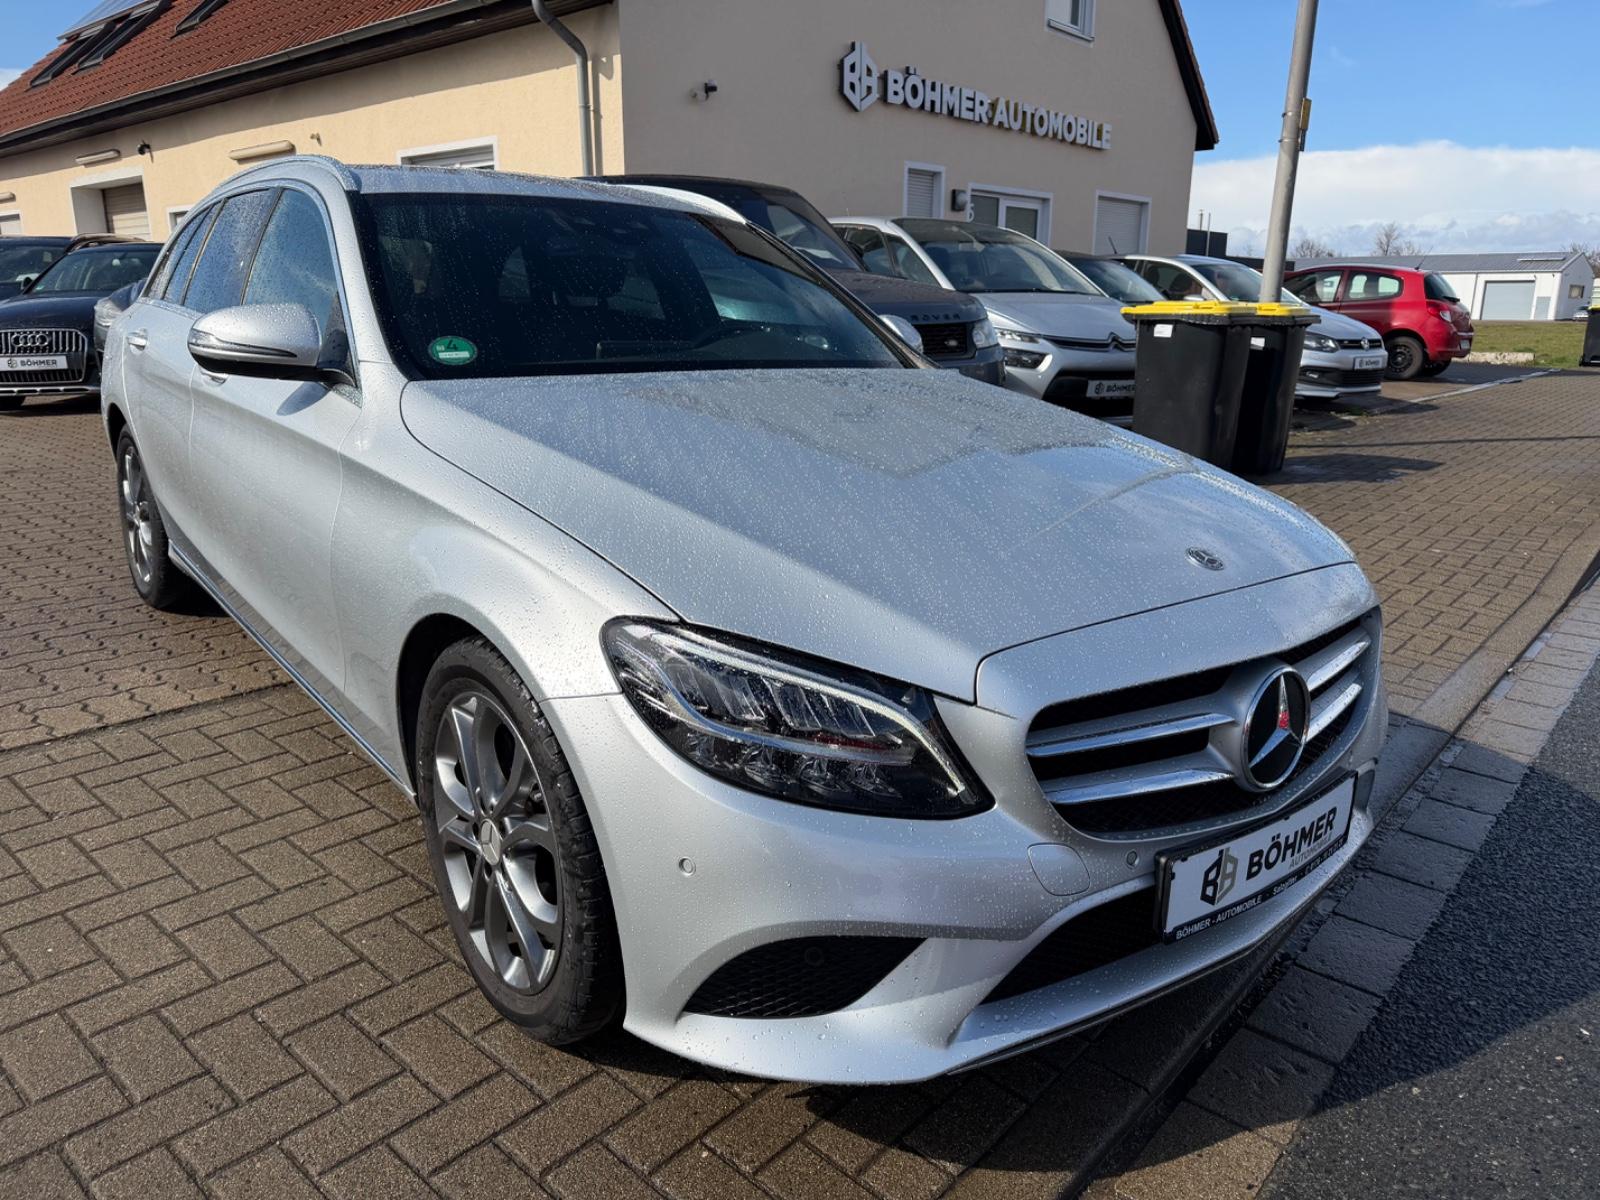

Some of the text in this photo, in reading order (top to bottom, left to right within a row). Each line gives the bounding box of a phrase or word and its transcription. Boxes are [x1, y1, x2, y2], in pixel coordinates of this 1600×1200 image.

[885, 65, 989, 123] BÖHMER
[992, 96, 1112, 150] AUTOMOBILE
[20, 358, 57, 367] BÖHMER
[446, 339, 458, 351] 4
[1245, 806, 1338, 881] BÖHMER
[1175, 917, 1211, 940] BÖHMER
[1215, 894, 1263, 922] AUTOMOBILE
